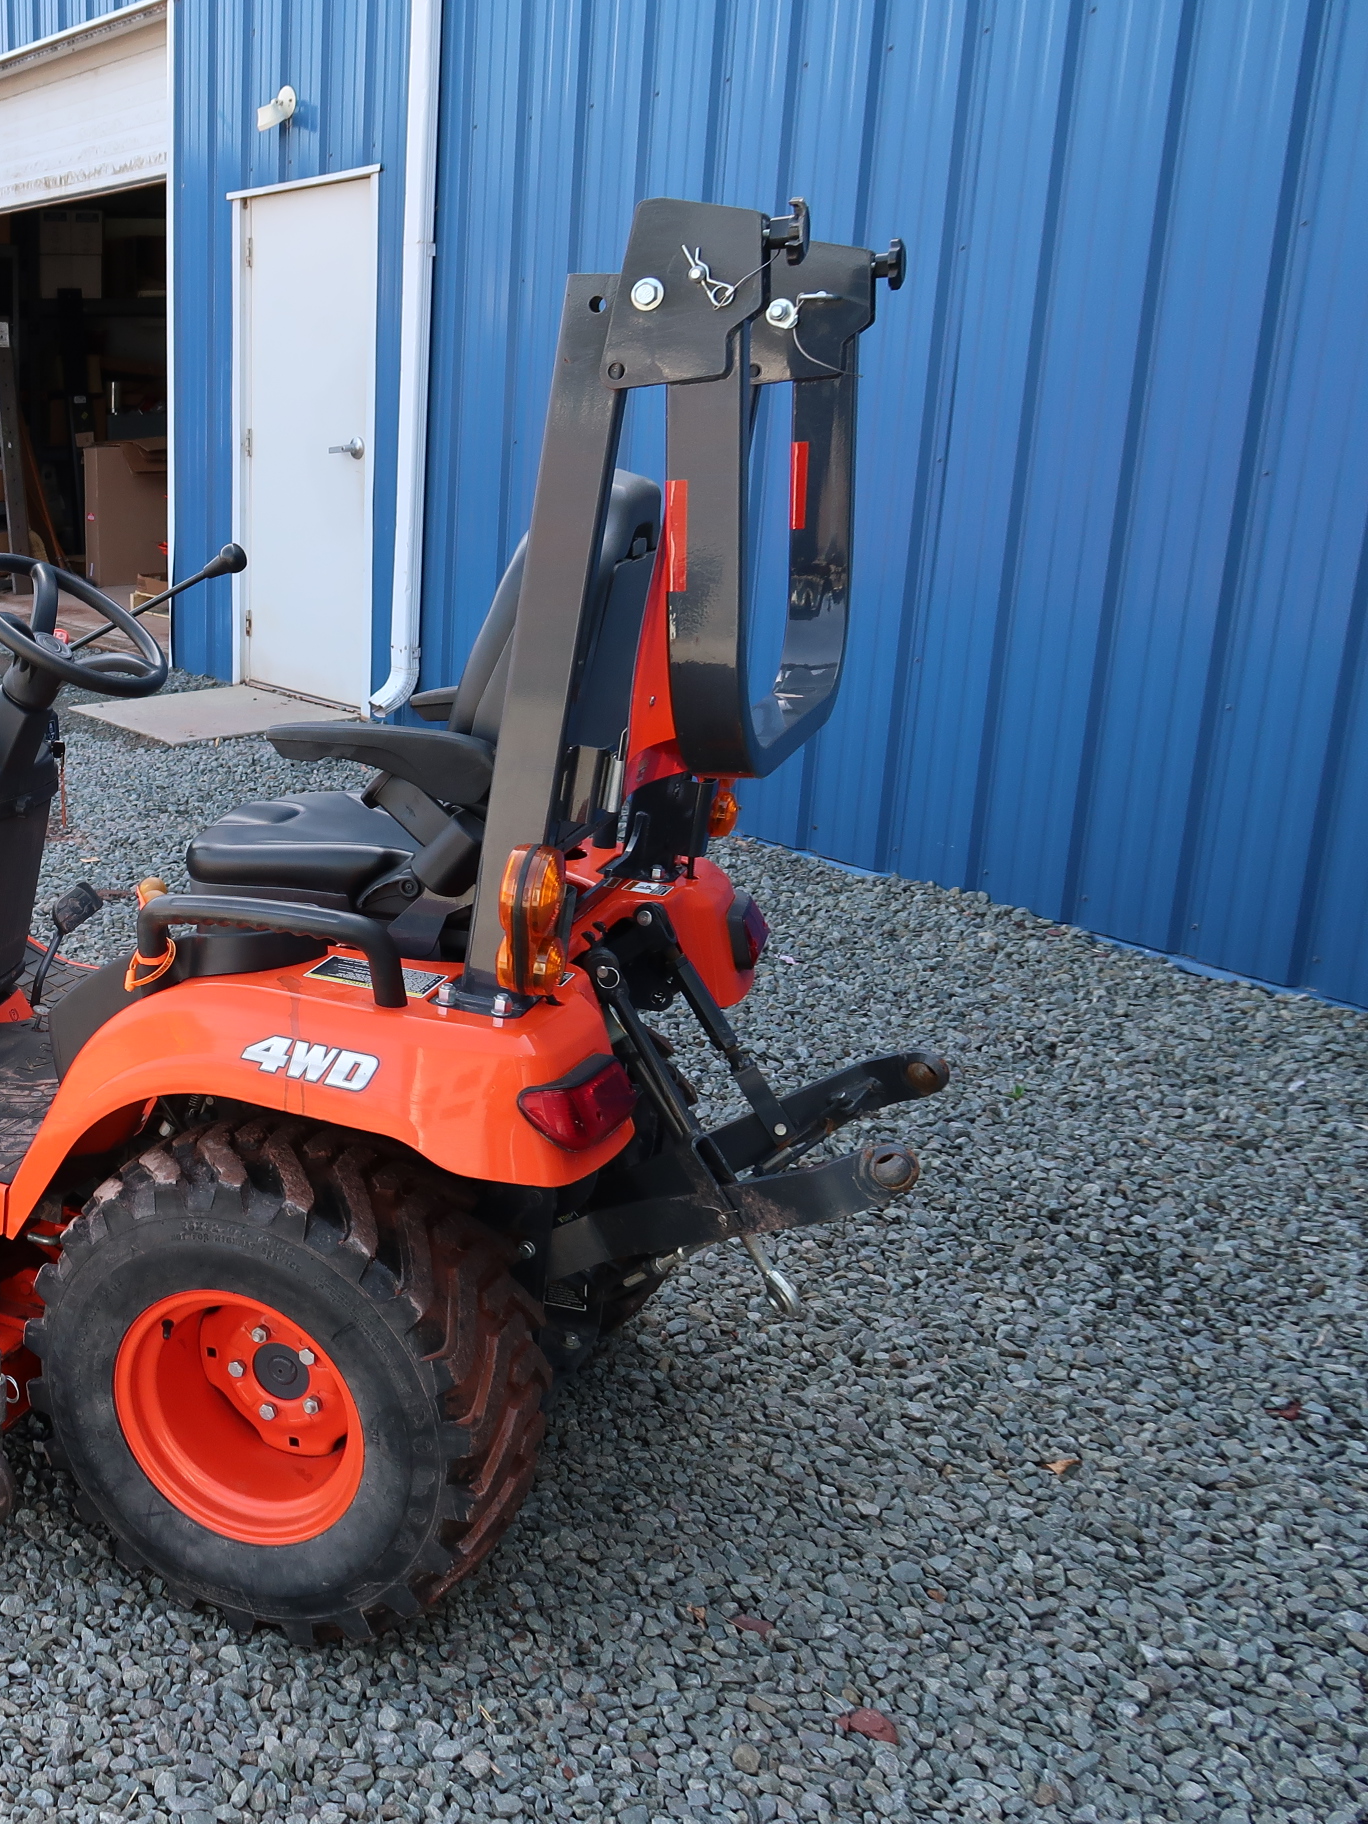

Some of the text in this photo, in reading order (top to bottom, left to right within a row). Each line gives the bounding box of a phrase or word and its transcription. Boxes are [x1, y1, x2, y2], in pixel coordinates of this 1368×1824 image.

[240, 1034, 380, 1092] 4WD
[191, 1232, 209, 1242] FOR
[260, 1247, 302, 1273] SERVICE
